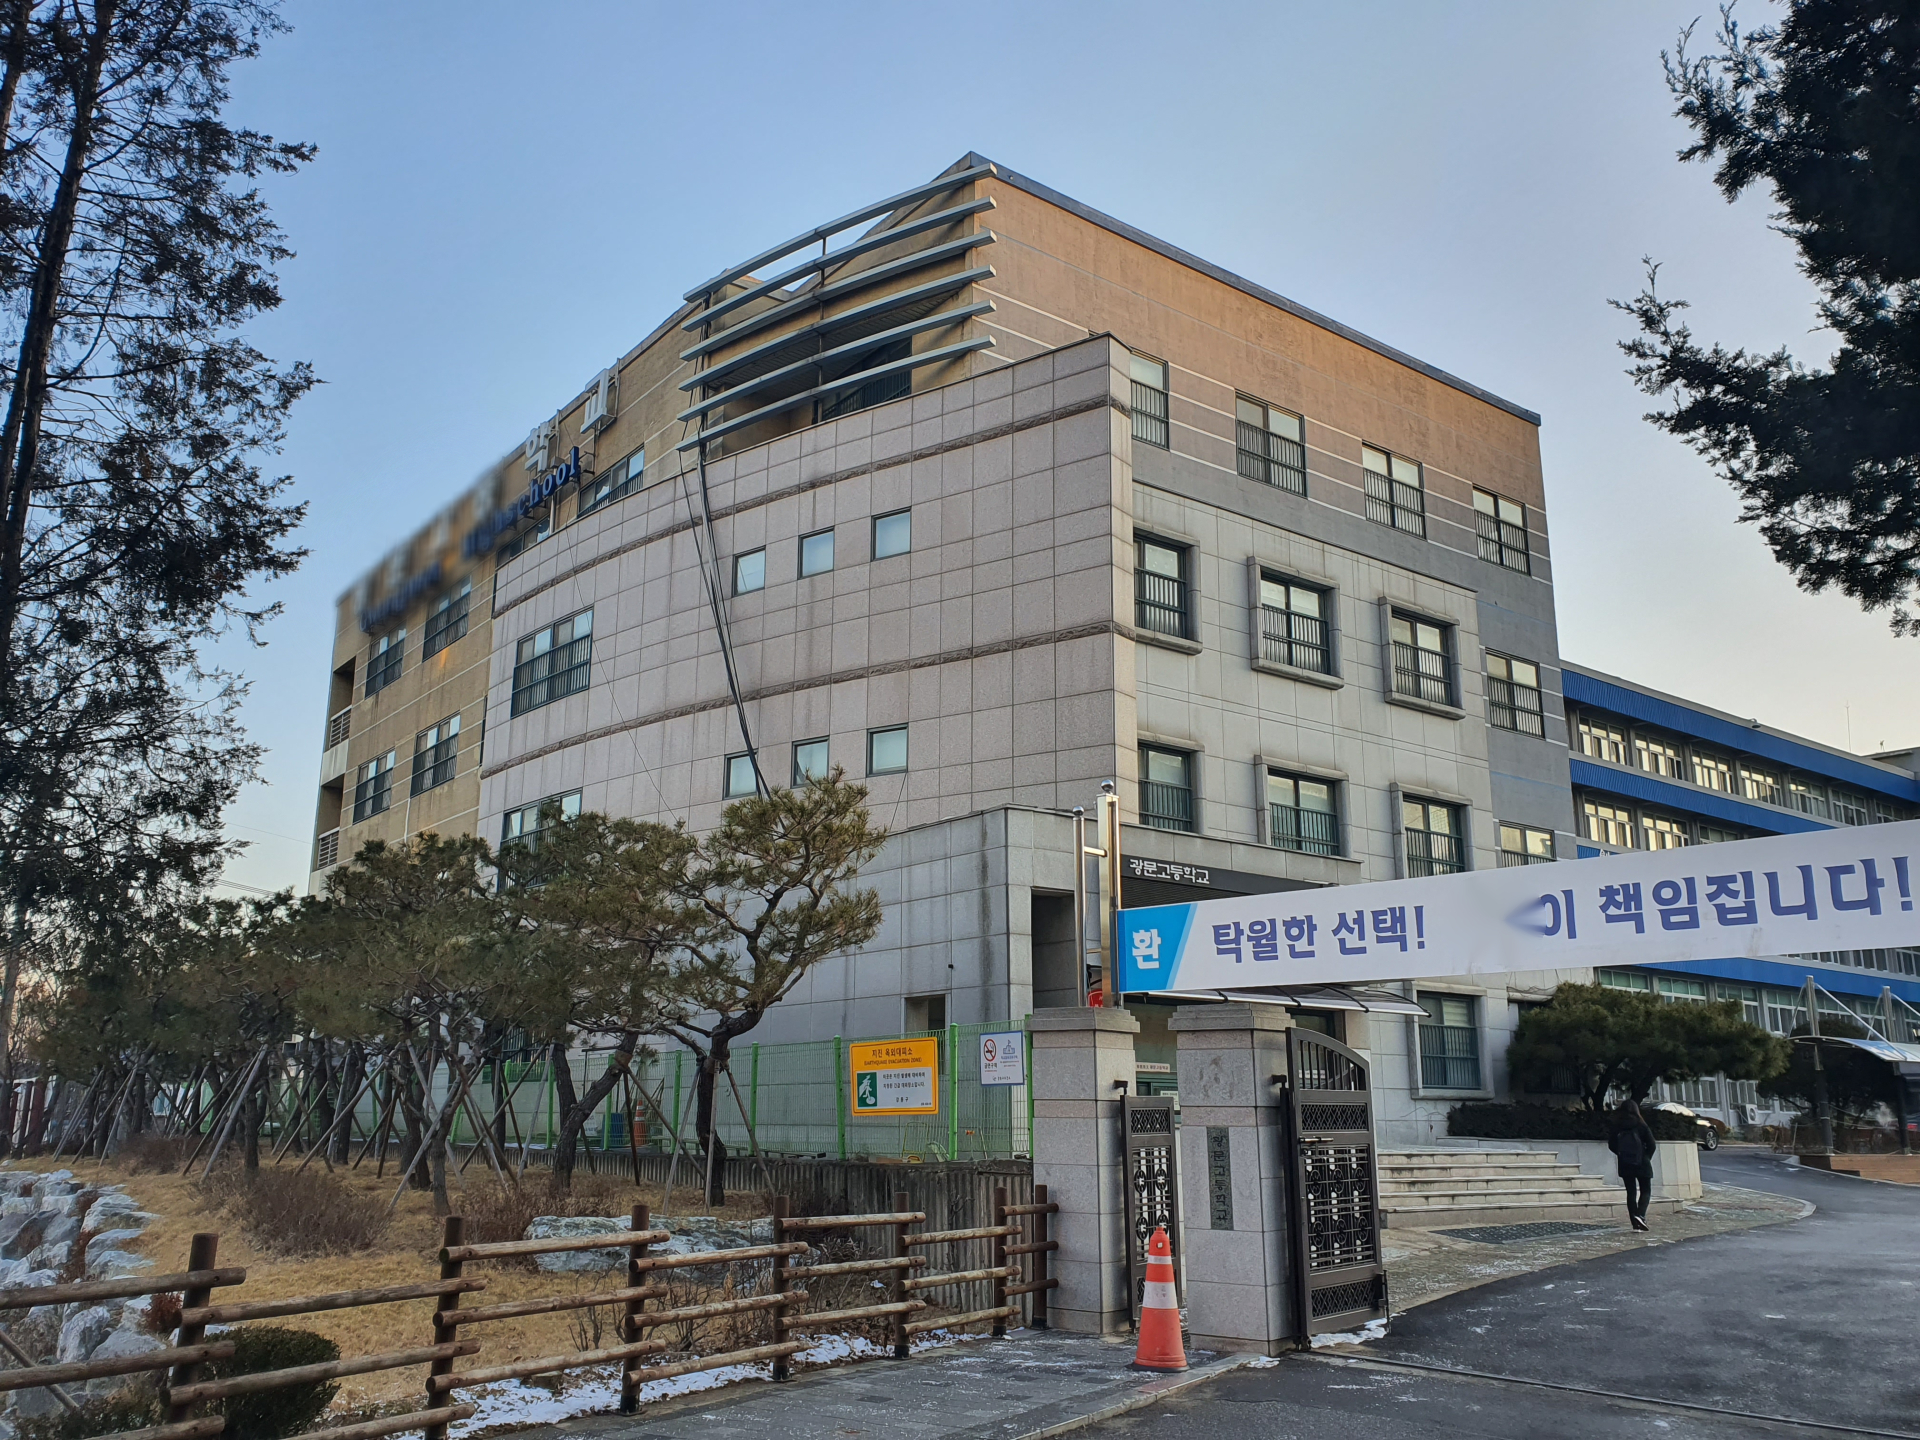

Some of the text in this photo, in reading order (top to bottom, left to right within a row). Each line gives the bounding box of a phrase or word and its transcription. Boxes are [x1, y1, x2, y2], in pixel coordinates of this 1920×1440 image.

[1129, 858, 1210, 885] 광문고등학교
[1211, 914, 1318, 964] 탁월한
[1330, 904, 1426, 957] 선택!
[1598, 855, 1914, 935] 책임집니다!
[1131, 927, 1162, 970] 환
[871, 1046, 913, 1058] 지진 옥외대피소
